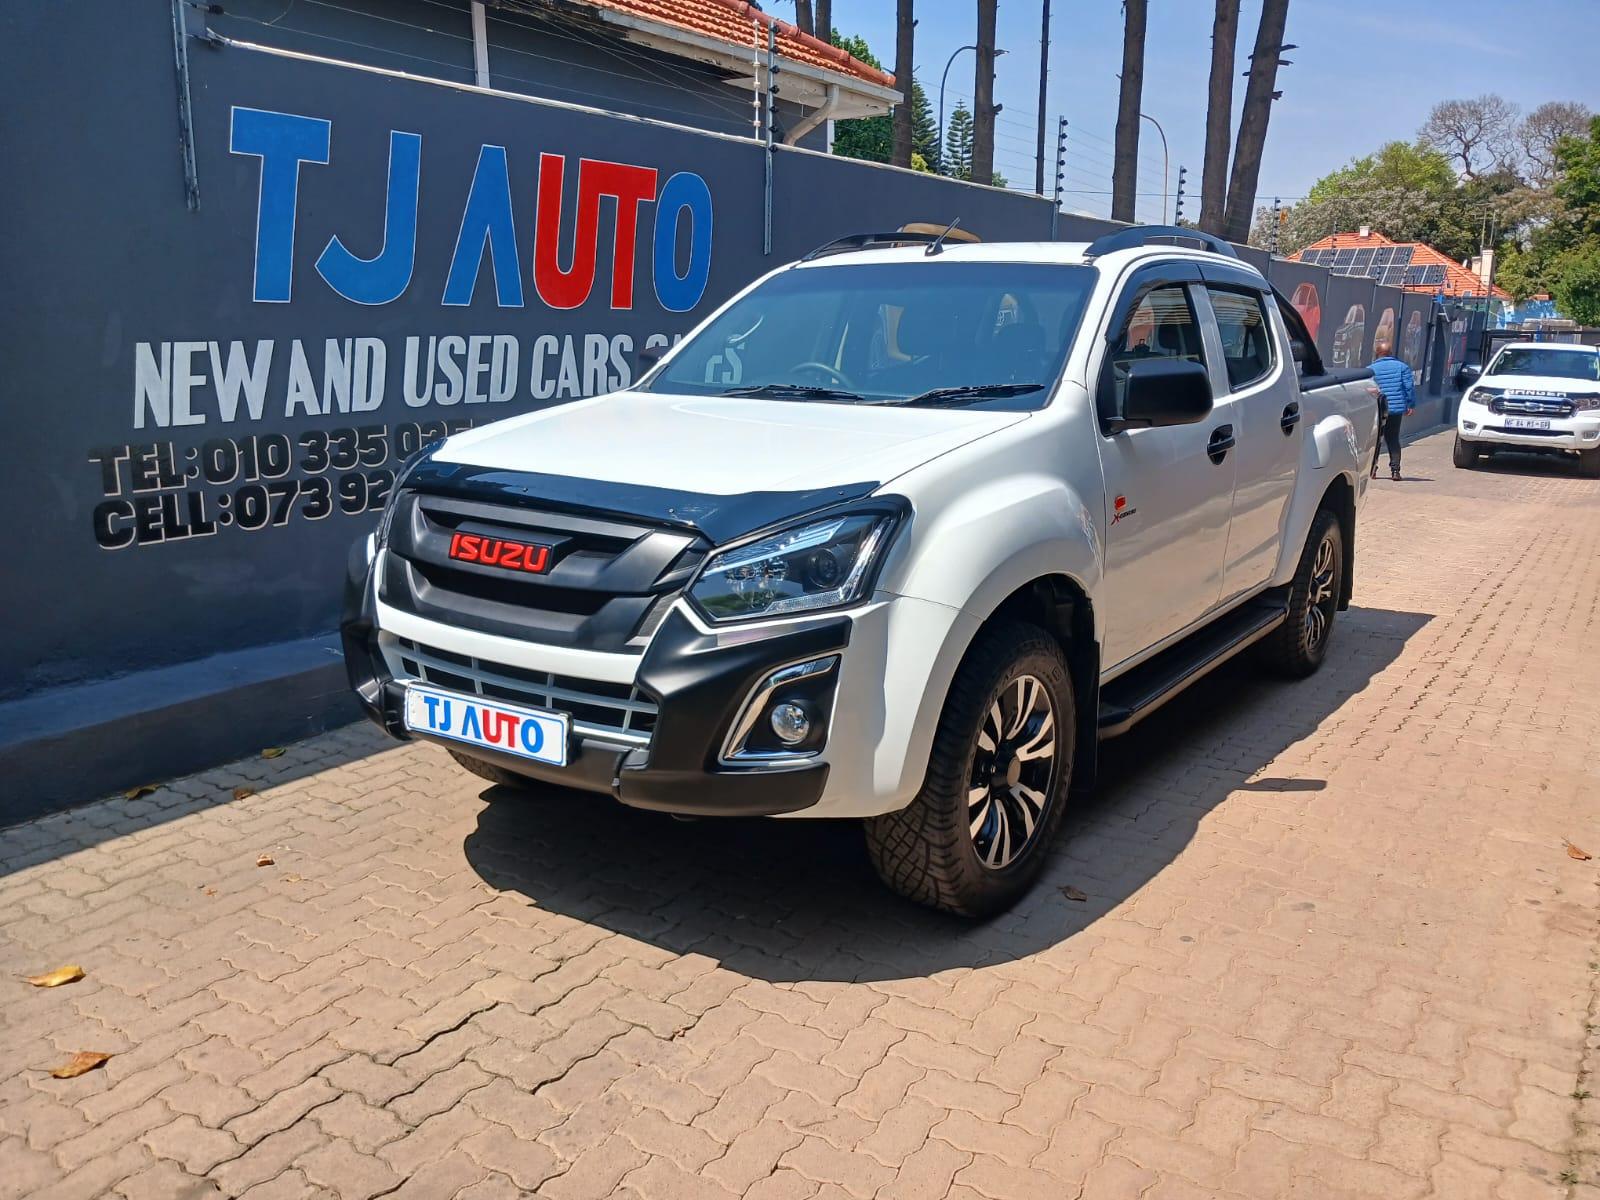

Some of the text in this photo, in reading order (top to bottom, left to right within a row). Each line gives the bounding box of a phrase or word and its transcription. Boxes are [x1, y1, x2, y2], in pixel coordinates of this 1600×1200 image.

[229, 105, 714, 313] TJ AUTO
[133, 339, 275, 429] NEW
[284, 336, 388, 417] AND
[403, 334, 520, 408] USED
[530, 333, 634, 400] CARS
[298, 423, 390, 475] 335
[450, 531, 549, 573] ISUZU
[423, 695, 544, 754] TJ AUTO
